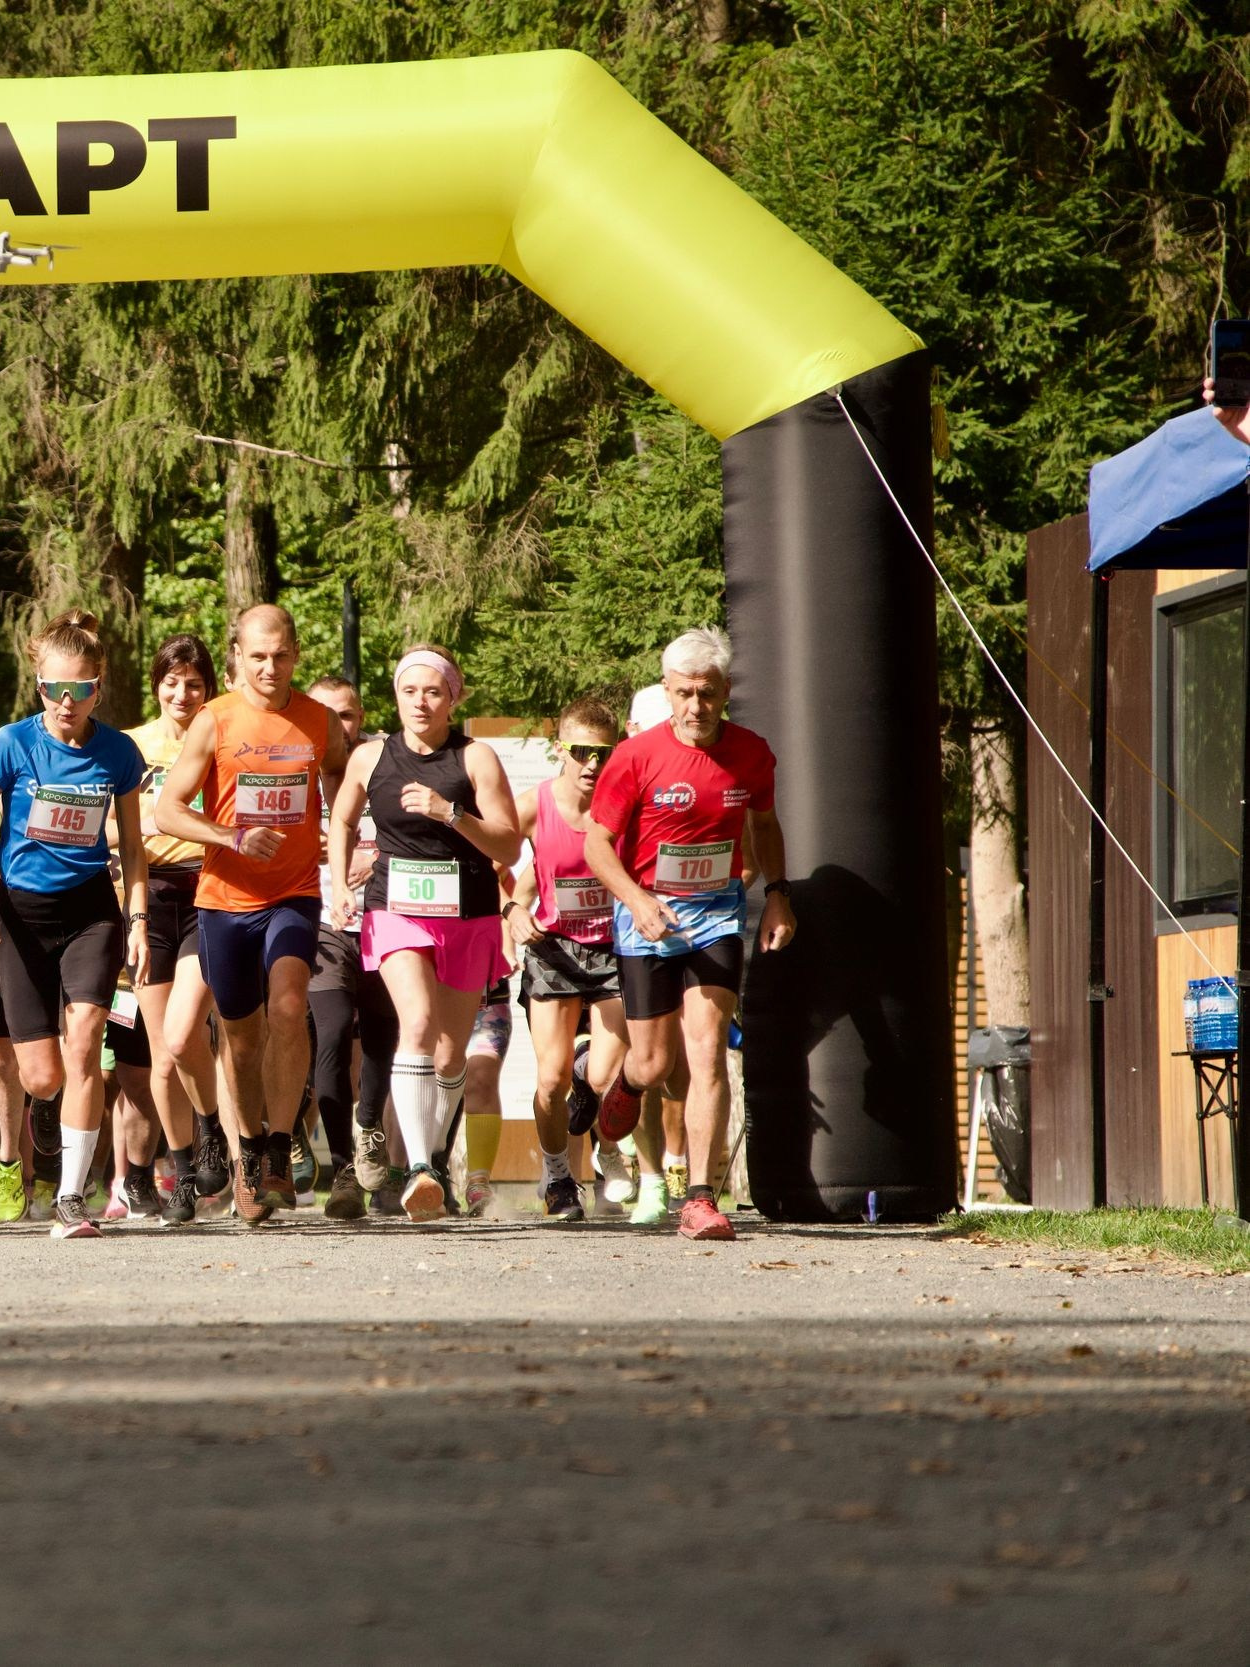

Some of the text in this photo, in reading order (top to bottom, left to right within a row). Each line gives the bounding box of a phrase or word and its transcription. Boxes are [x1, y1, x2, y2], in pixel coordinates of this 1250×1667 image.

[253, 744, 314, 755] DEMIX
[245, 776, 302, 786] КРОСС ДУБКИ
[42, 791, 100, 806] КРОСС ДУБКИ
[255, 789, 292, 812] 146
[653, 792, 691, 805] БЕГИ
[50, 806, 87, 832] 145
[667, 845, 726, 856] КРОСС ДУБКИ
[395, 863, 452, 874] КРОСС ДУБКИ
[678, 858, 713, 880] 170
[408, 877, 435, 901] 50
[574, 888, 609, 908] 167
